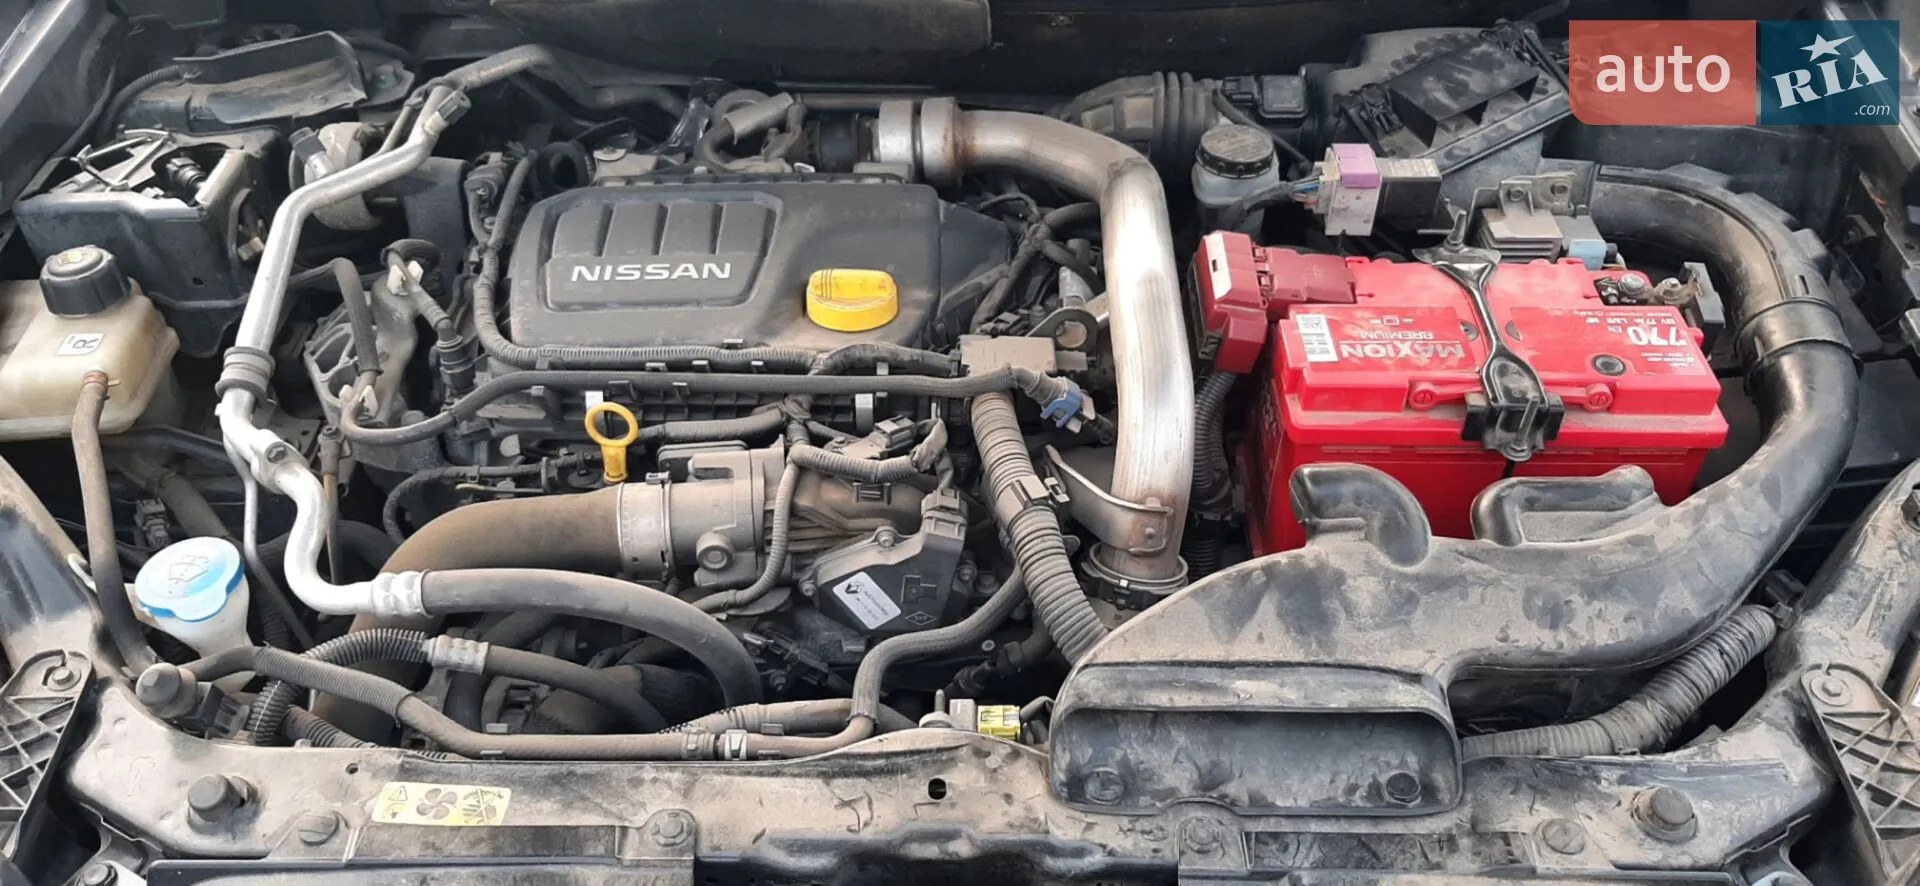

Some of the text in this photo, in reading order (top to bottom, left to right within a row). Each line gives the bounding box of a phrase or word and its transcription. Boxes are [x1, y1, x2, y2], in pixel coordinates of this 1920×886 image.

[571, 262, 731, 282] NISSAN
[1360, 330, 1435, 340] PREMIUM
[1627, 326, 1687, 346] 770
[1339, 341, 1466, 359] MAXION
